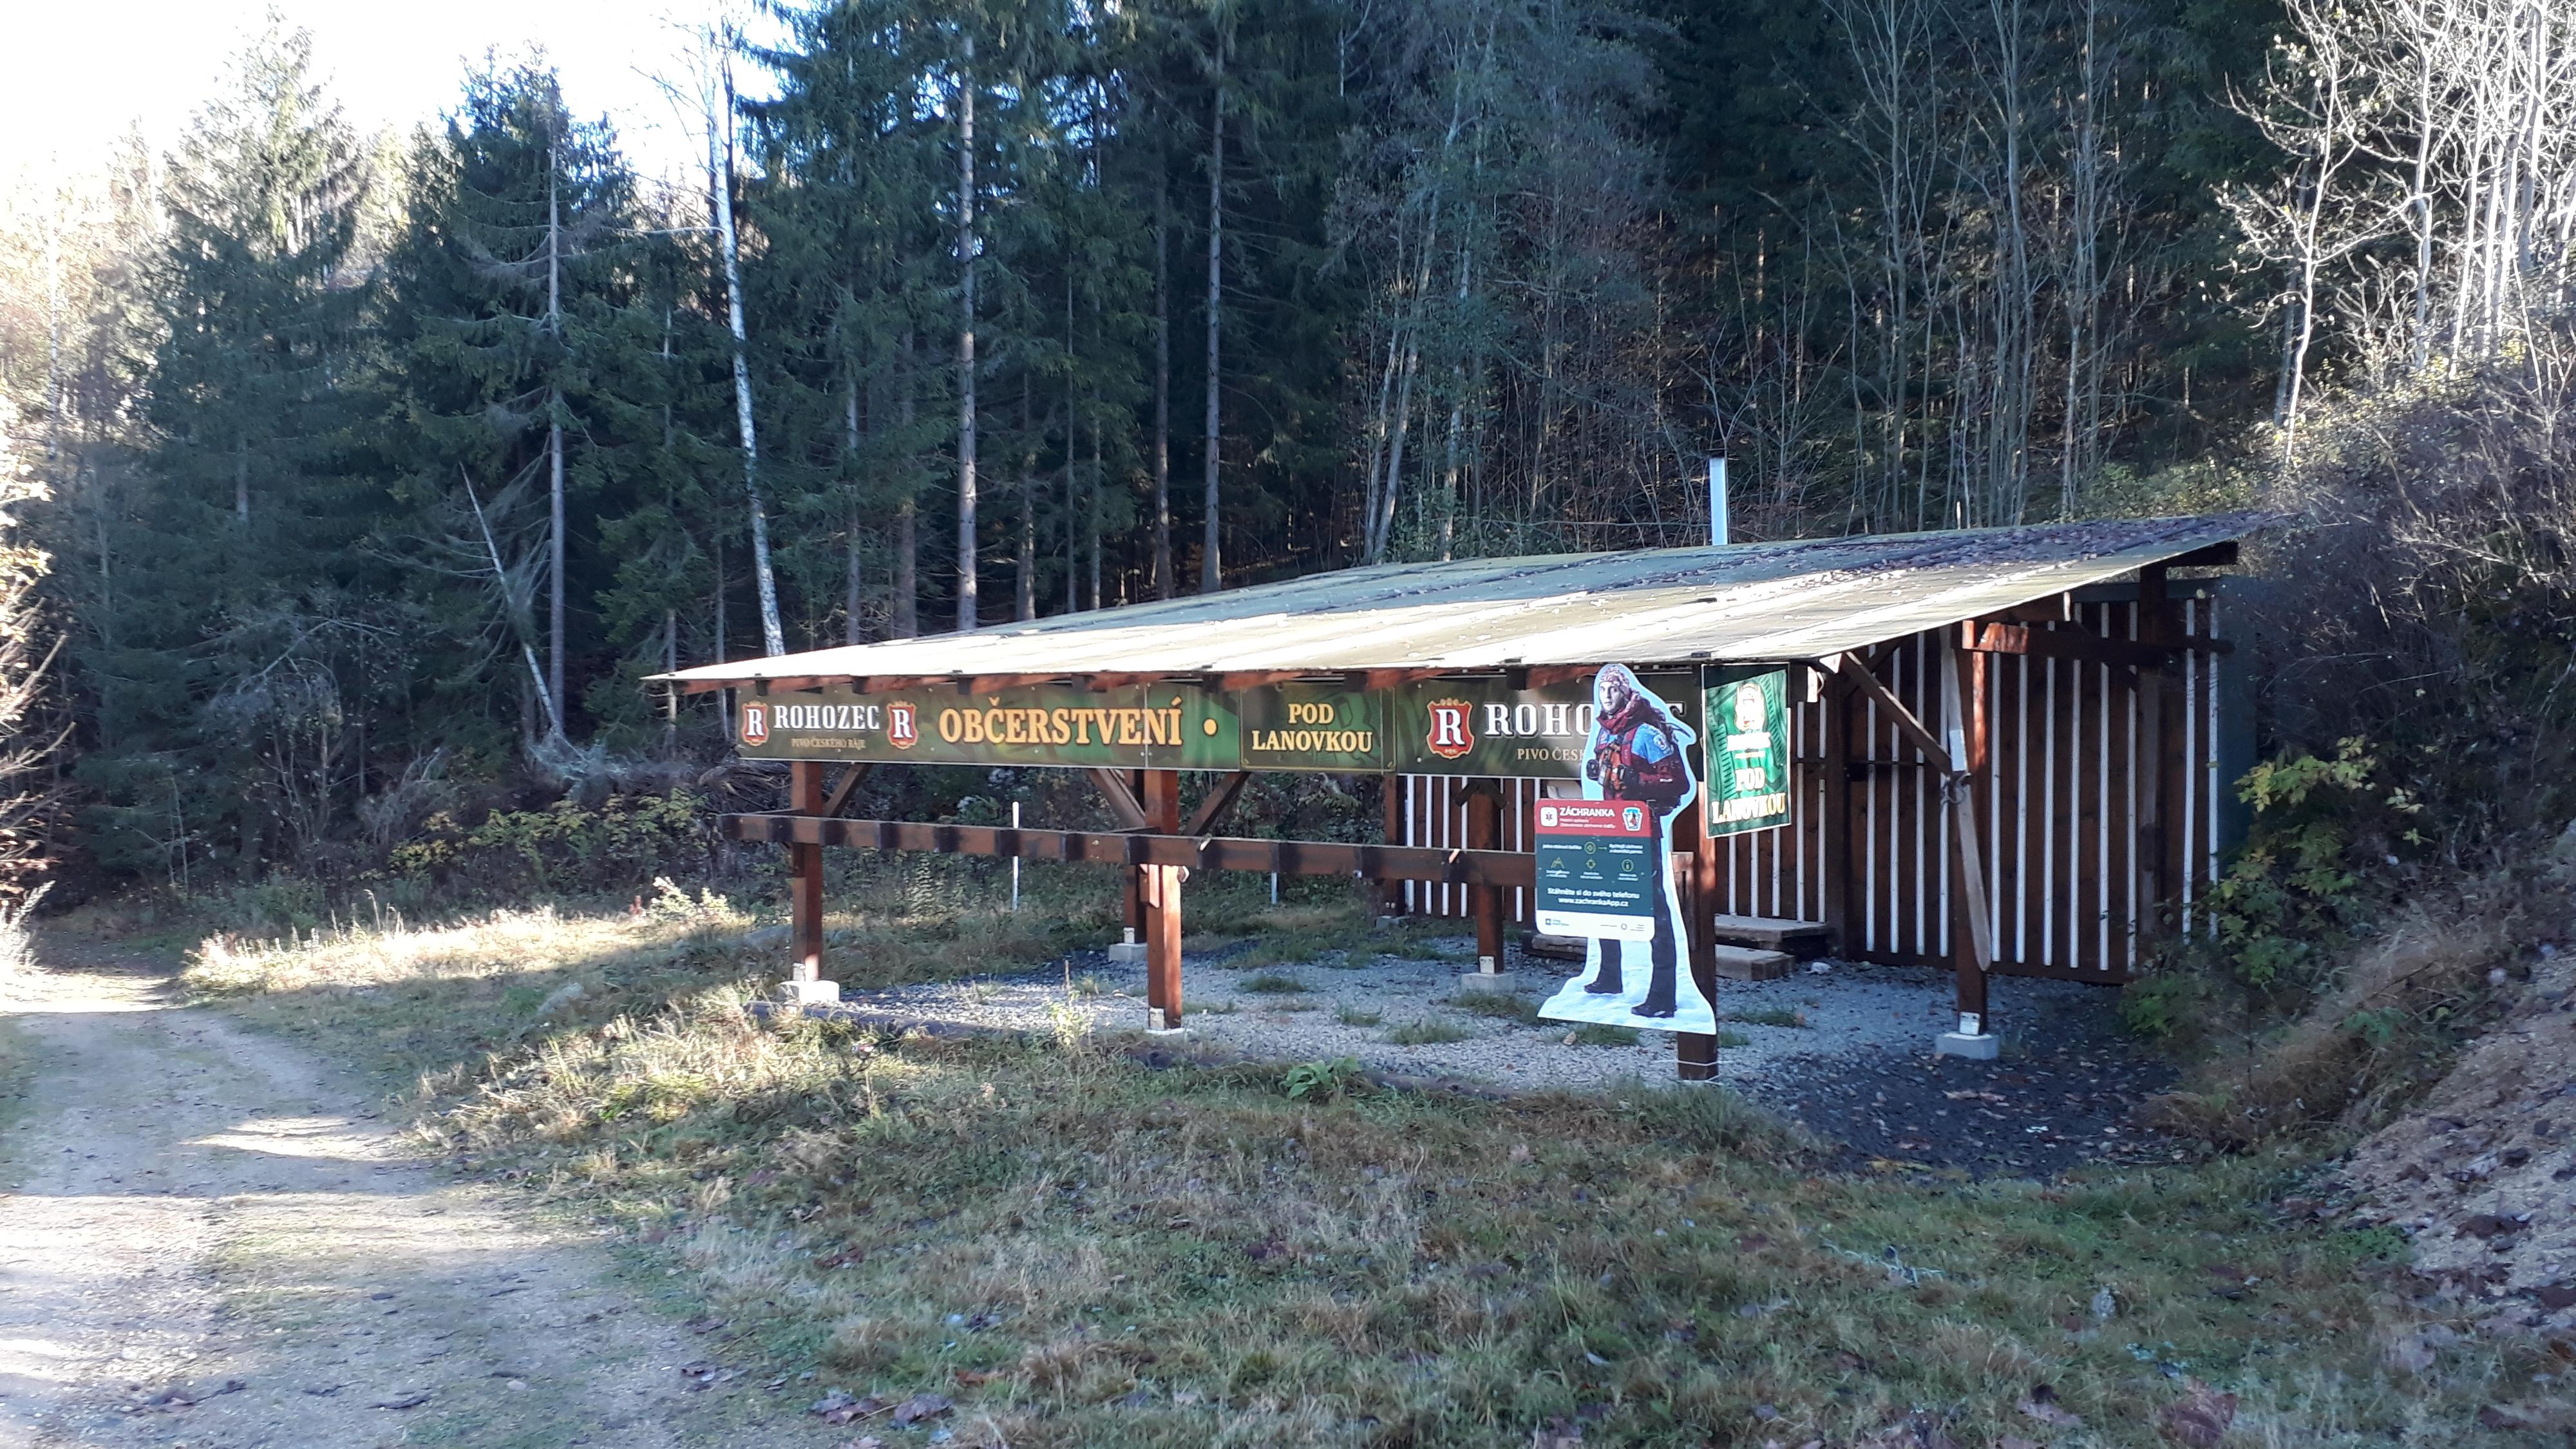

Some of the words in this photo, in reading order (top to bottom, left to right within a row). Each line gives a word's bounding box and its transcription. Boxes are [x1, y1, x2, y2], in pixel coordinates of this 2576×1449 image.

[746, 708, 765, 736] R
[773, 705, 880, 730] ROHOZEC
[891, 708, 913, 739] R
[939, 696, 1184, 746] OBČERSTVENÍ
[1288, 703, 1335, 724] POD
[1435, 709, 1466, 745] R
[1252, 730, 1373, 752] LANOVKOU
[1517, 748, 1549, 761] PIVO
[1736, 767, 1765, 791] POD
[1560, 806, 1615, 817] ZÁCHRANKA
[1712, 792, 1786, 824] LANOVKOU
